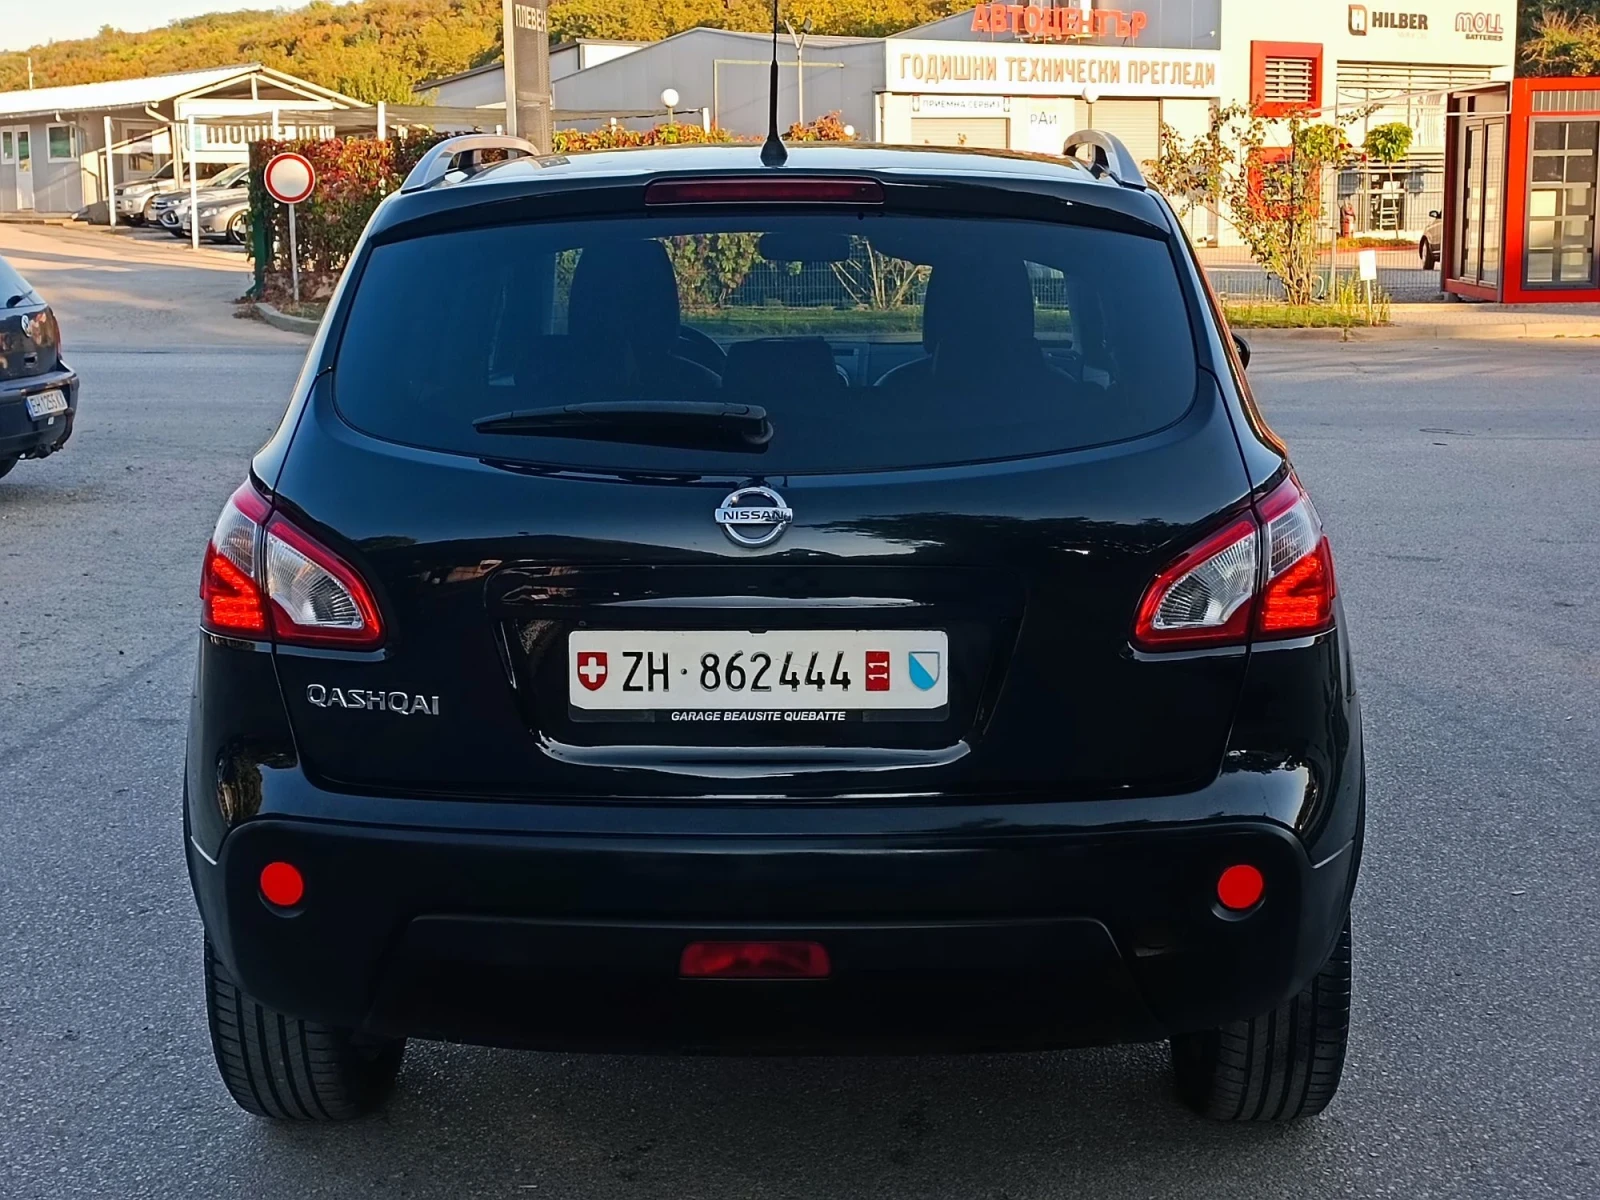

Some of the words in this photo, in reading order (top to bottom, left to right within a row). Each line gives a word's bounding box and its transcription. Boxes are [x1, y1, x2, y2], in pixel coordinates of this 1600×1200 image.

[515, 4, 547, 33] ПЛЕВЕН
[970, 3, 1148, 41] АВТОЦЕНТЪР
[1371, 11, 1429, 30] HILBER
[1455, 12, 1504, 34] MOLL
[1465, 33, 1504, 42] BATTERIES
[900, 53, 997, 84] ГОДИШНИ
[1005, 56, 1121, 84] ТЕХНИЧЕСКИ
[1128, 60, 1216, 89] ПРЕГЛЕДИ
[723, 510, 784, 521] NISSAN
[621, 650, 670, 693] ZH
[699, 650, 852, 693] 862444
[868, 660, 888, 681] 11
[306, 683, 440, 716] QASHQAI
[671, 711, 722, 721] GARAGE
[723, 711, 782, 721] BEAUSITE
[784, 711, 847, 721] QUEBATTE
